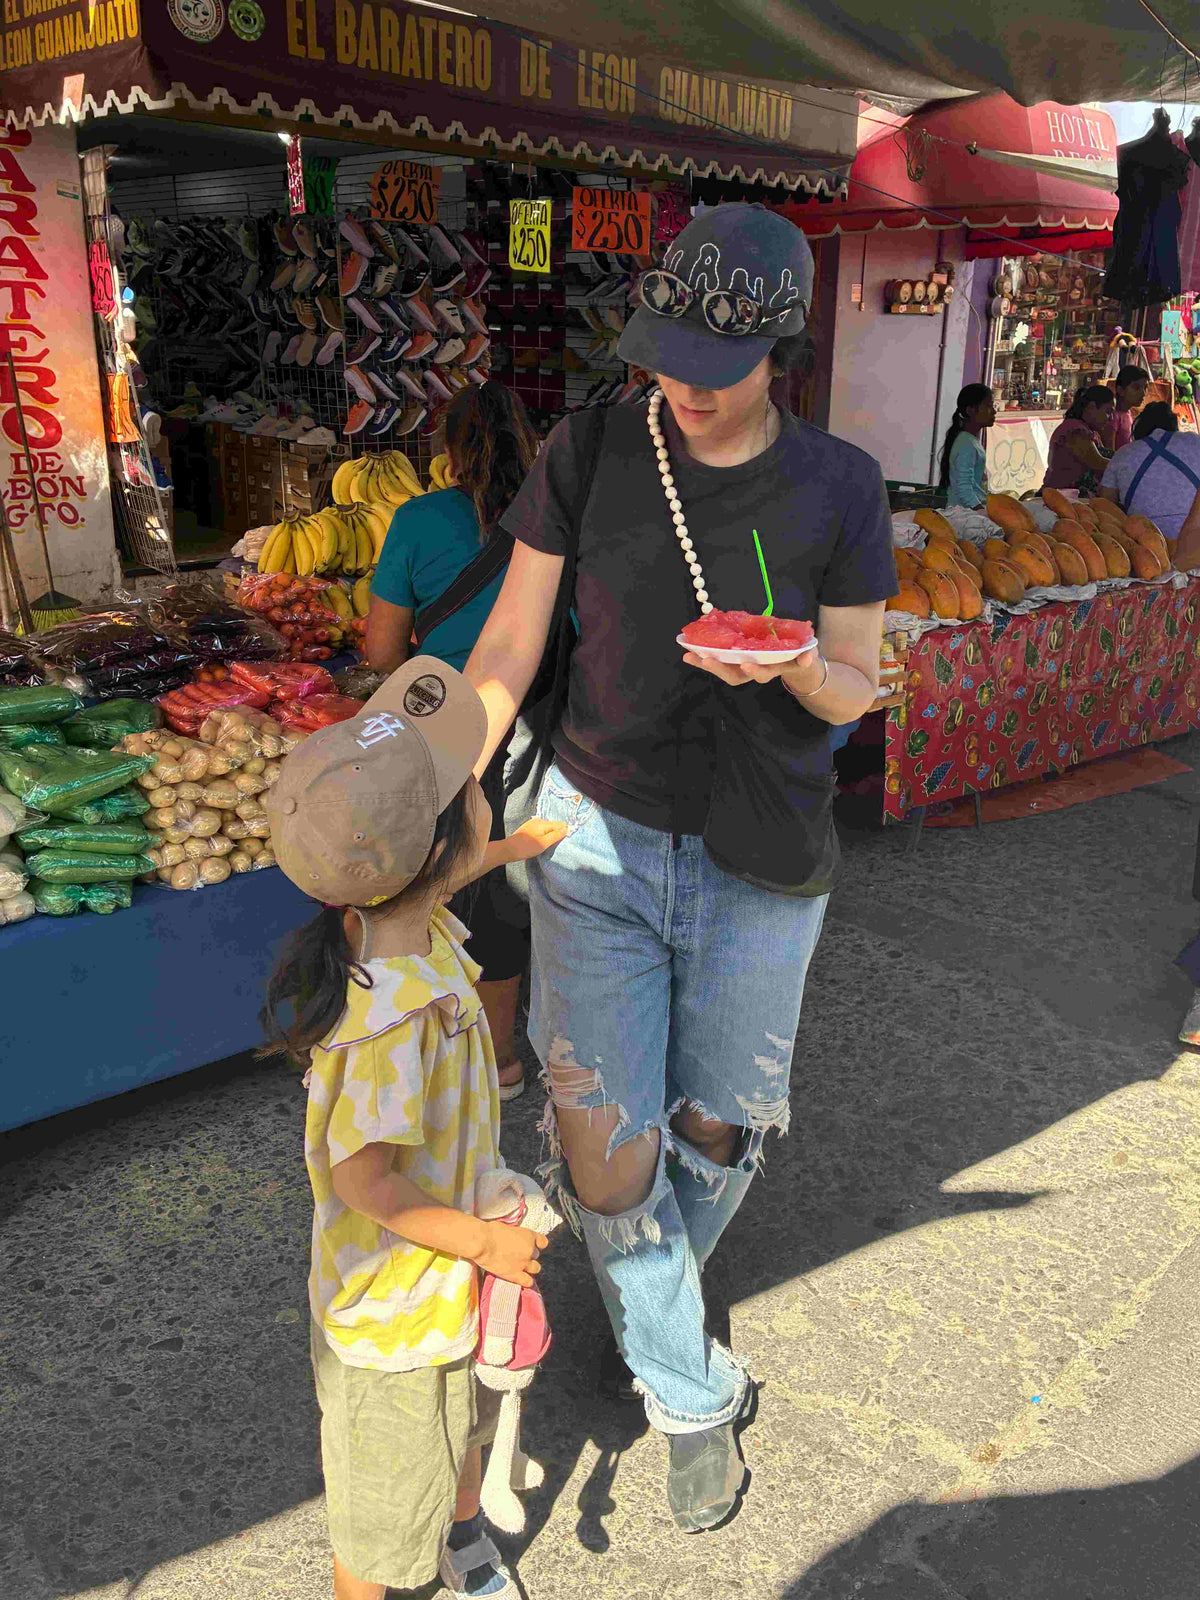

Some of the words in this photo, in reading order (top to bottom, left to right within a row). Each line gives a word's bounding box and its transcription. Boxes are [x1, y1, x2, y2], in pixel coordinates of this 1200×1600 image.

[35, 0, 138, 61] GUANAJUATO
[286, 0, 325, 60] EL
[335, 0, 492, 91] BARATERO
[520, 38, 552, 99] DE
[577, 49, 637, 113] LEON
[658, 66, 793, 141] GUANAJUATO
[382, 161, 433, 181] OFERTA
[377, 176, 435, 222] $250
[511, 202, 548, 226] OFERTA
[579, 187, 638, 211] OFERTA
[512, 228, 547, 267] $250
[575, 210, 643, 250] $250
[10, 452, 63, 475] DE
